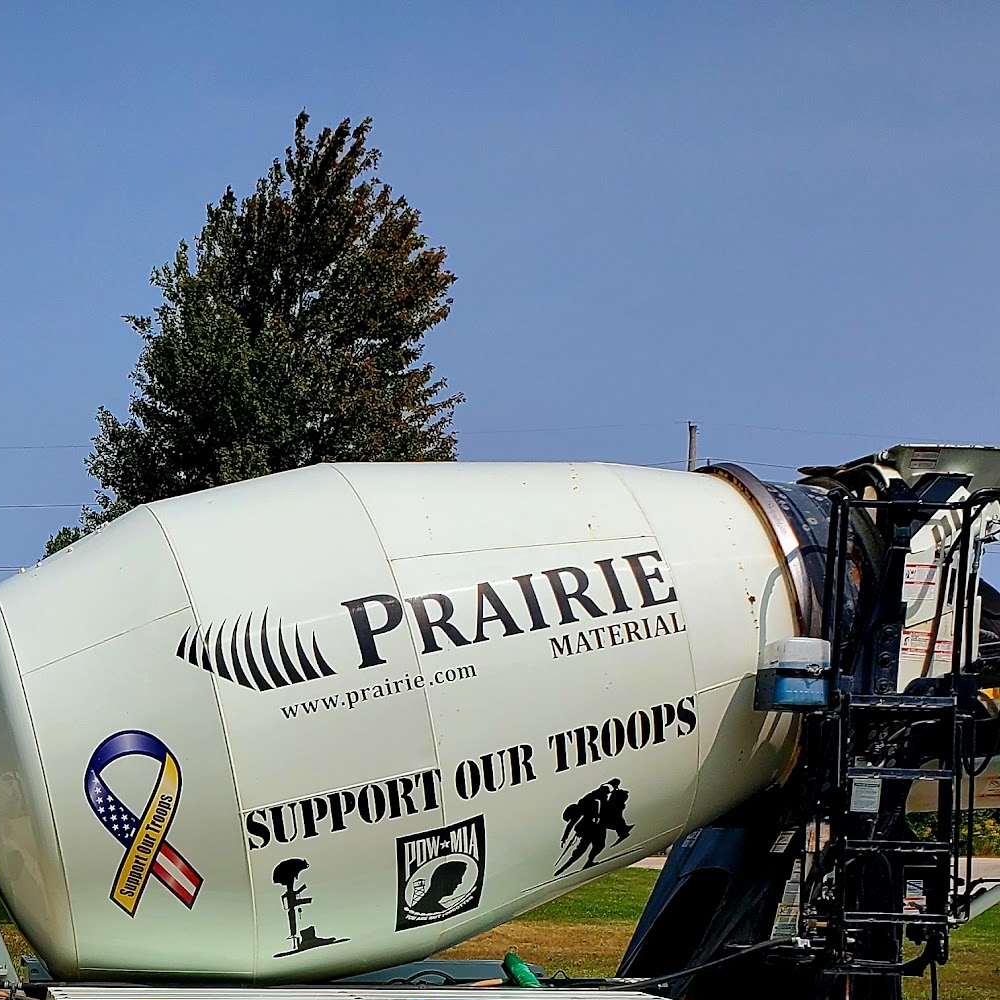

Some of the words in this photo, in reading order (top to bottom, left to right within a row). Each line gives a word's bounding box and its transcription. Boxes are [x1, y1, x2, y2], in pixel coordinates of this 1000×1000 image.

[341, 550, 679, 670] PRAIRIE
[548, 612, 687, 659] MATERIAL
[280, 662, 478, 720] www.prairie.com
[244, 768, 442, 850] SUPPORT
[454, 743, 537, 800] OUR
[548, 696, 697, 774] TROOPS
[145, 794, 173, 833] Troops
[136, 833, 157, 855] Our
[404, 835, 440, 882] POW
[449, 822, 479, 861] MIA
[120, 854, 149, 898] Support
